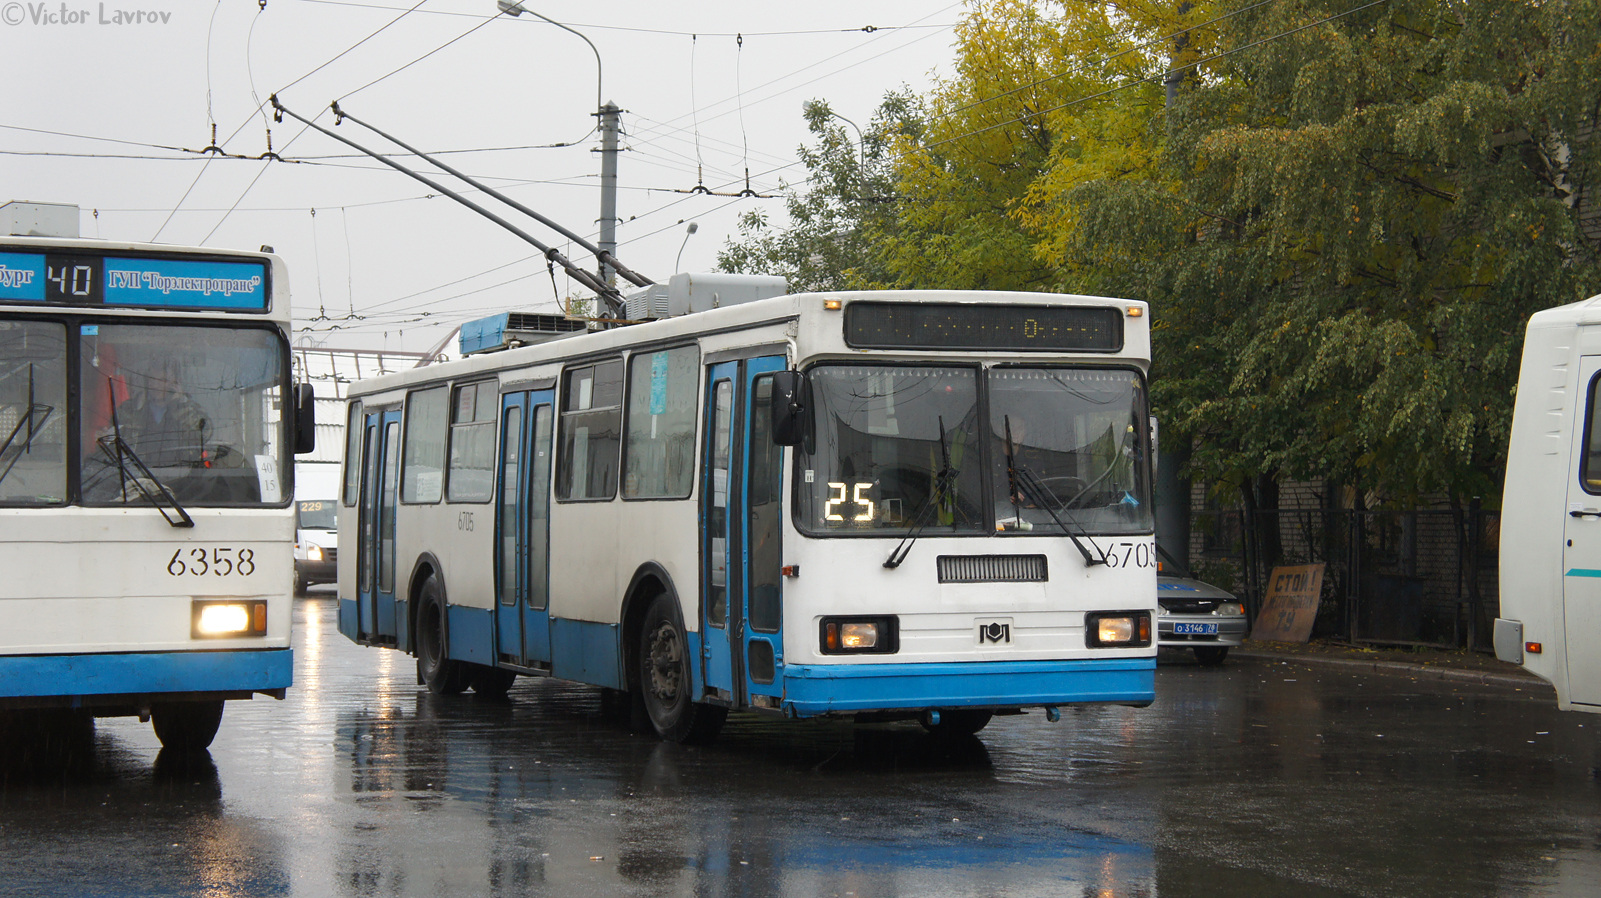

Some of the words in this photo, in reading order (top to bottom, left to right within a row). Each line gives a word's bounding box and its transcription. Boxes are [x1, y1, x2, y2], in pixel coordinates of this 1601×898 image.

[47, 265, 92, 296] 40
[108, 270, 141, 289] ГУП
[261, 462, 273, 474] 40
[264, 480, 276, 491] 15
[301, 502, 322, 512] 229
[824, 482, 874, 521] 25
[458, 511, 474, 532] 6705
[167, 548, 256, 577] 6358
[1185, 624, 1203, 633] 3146
